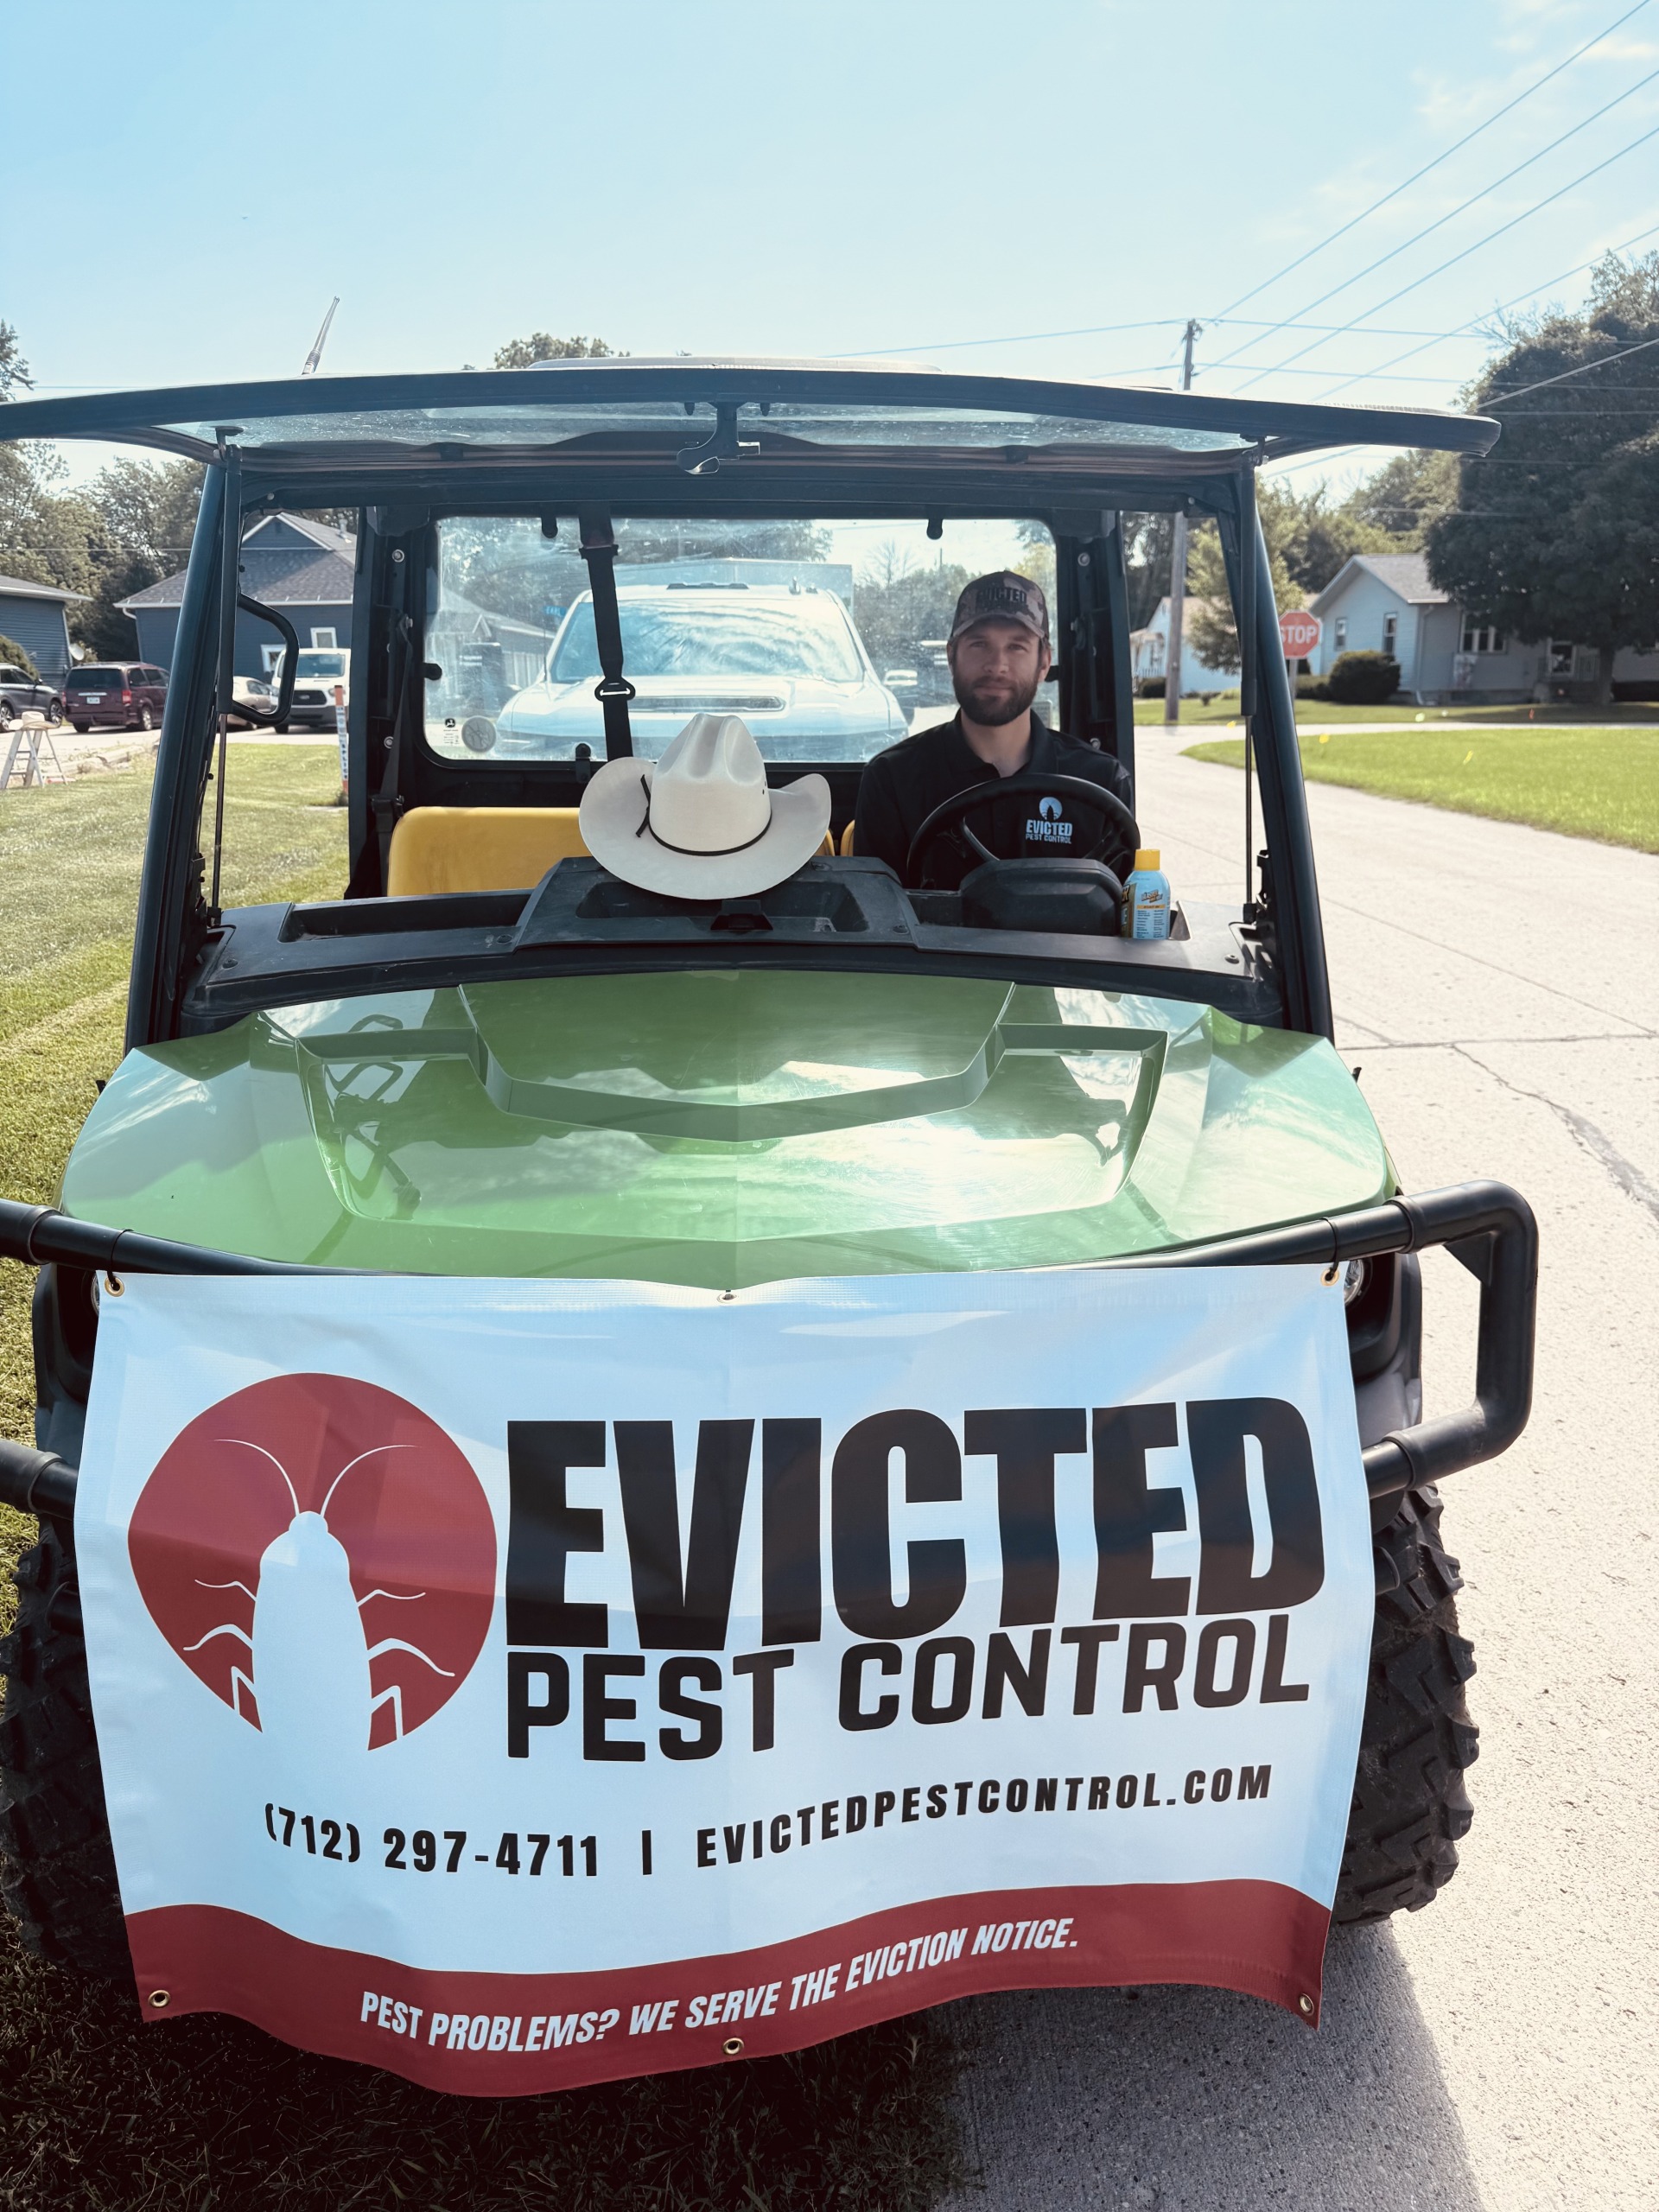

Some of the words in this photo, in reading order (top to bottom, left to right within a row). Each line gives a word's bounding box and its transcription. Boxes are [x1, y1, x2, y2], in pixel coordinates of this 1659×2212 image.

[1280, 625, 1318, 644] STOP
[1026, 819, 1073, 837] EVICTED
[1044, 835, 1072, 844] CONTROL
[506, 1397, 1324, 1650] EVICTED
[506, 1649, 795, 1761] PEST
[838, 1615, 1310, 1731] CONTROL
[265, 1802, 360, 1863] (712)
[383, 1827, 597, 1877] 297-4711
[696, 1764, 1272, 1868] EVICTEDPESTCONTROL.COM
[360, 1991, 423, 2039] PEST
[427, 2008, 620, 2052] PROBLEMS?
[628, 1999, 680, 2036] WE
[684, 1980, 783, 2029] SERVE
[788, 1962, 842, 2011] THE
[844, 1927, 969, 1993] EVICTION
[970, 1917, 1078, 1955] NOTICE.
